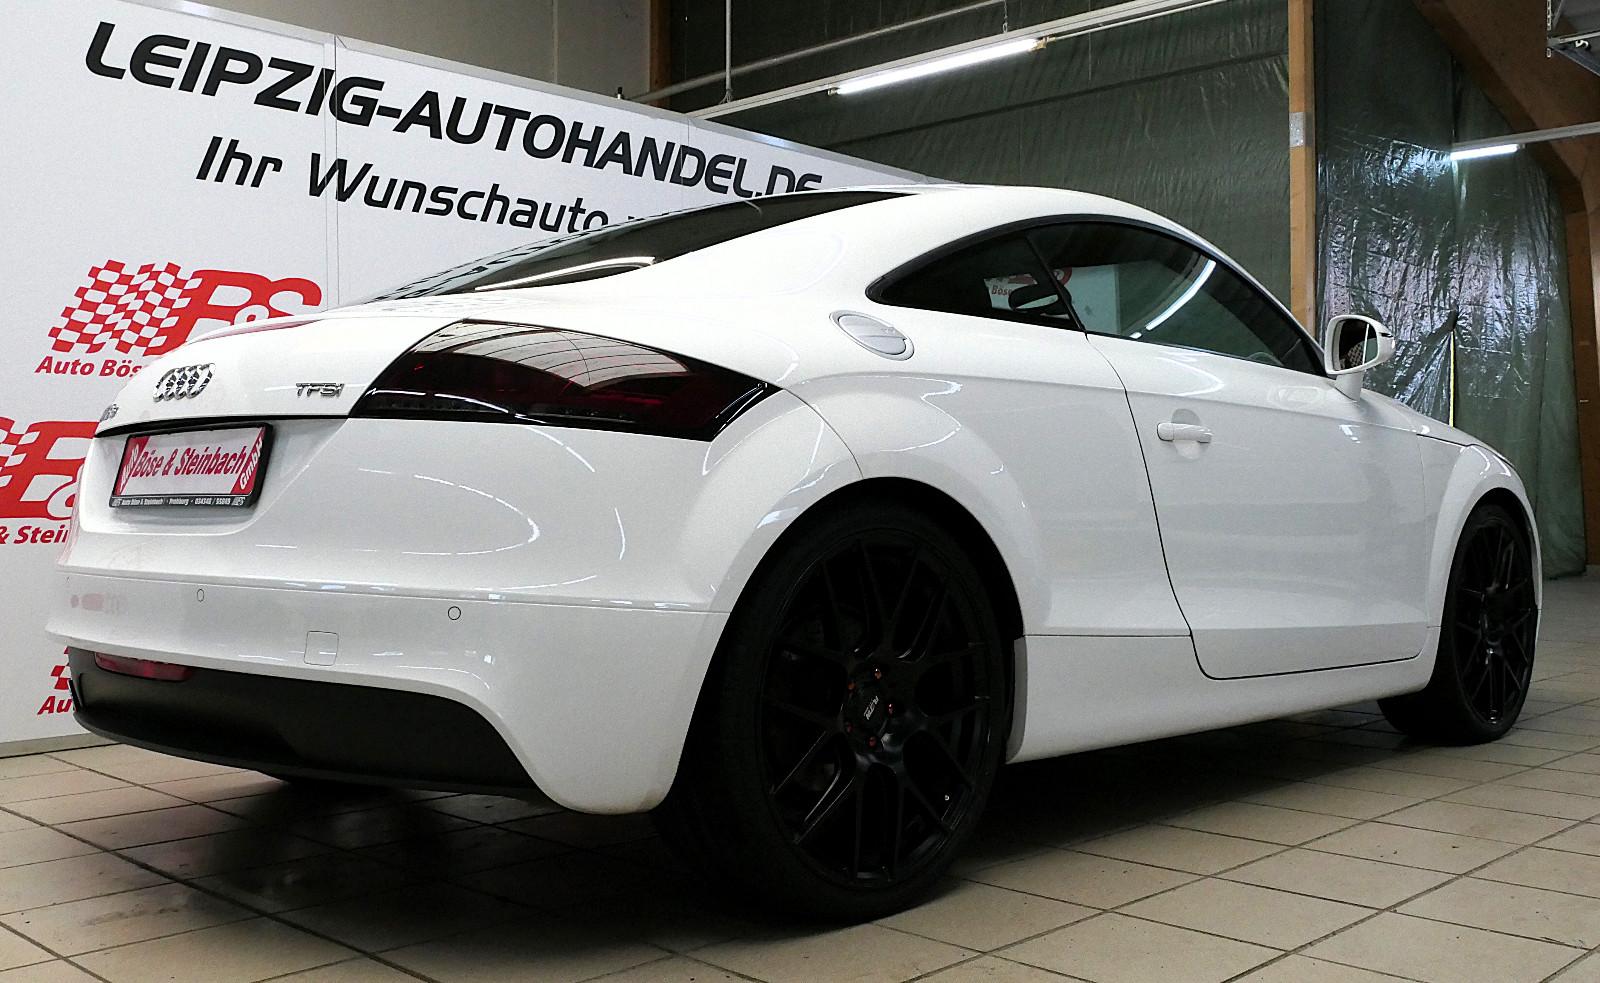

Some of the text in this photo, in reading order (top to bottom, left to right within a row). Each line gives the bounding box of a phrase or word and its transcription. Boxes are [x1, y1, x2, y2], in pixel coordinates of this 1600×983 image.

[196, 136, 609, 233] Ihr Wunschauto
[34, 356, 95, 376] Auto
[131, 446, 247, 477] Böse & Steinbach
[240, 436, 262, 490] GmbH
